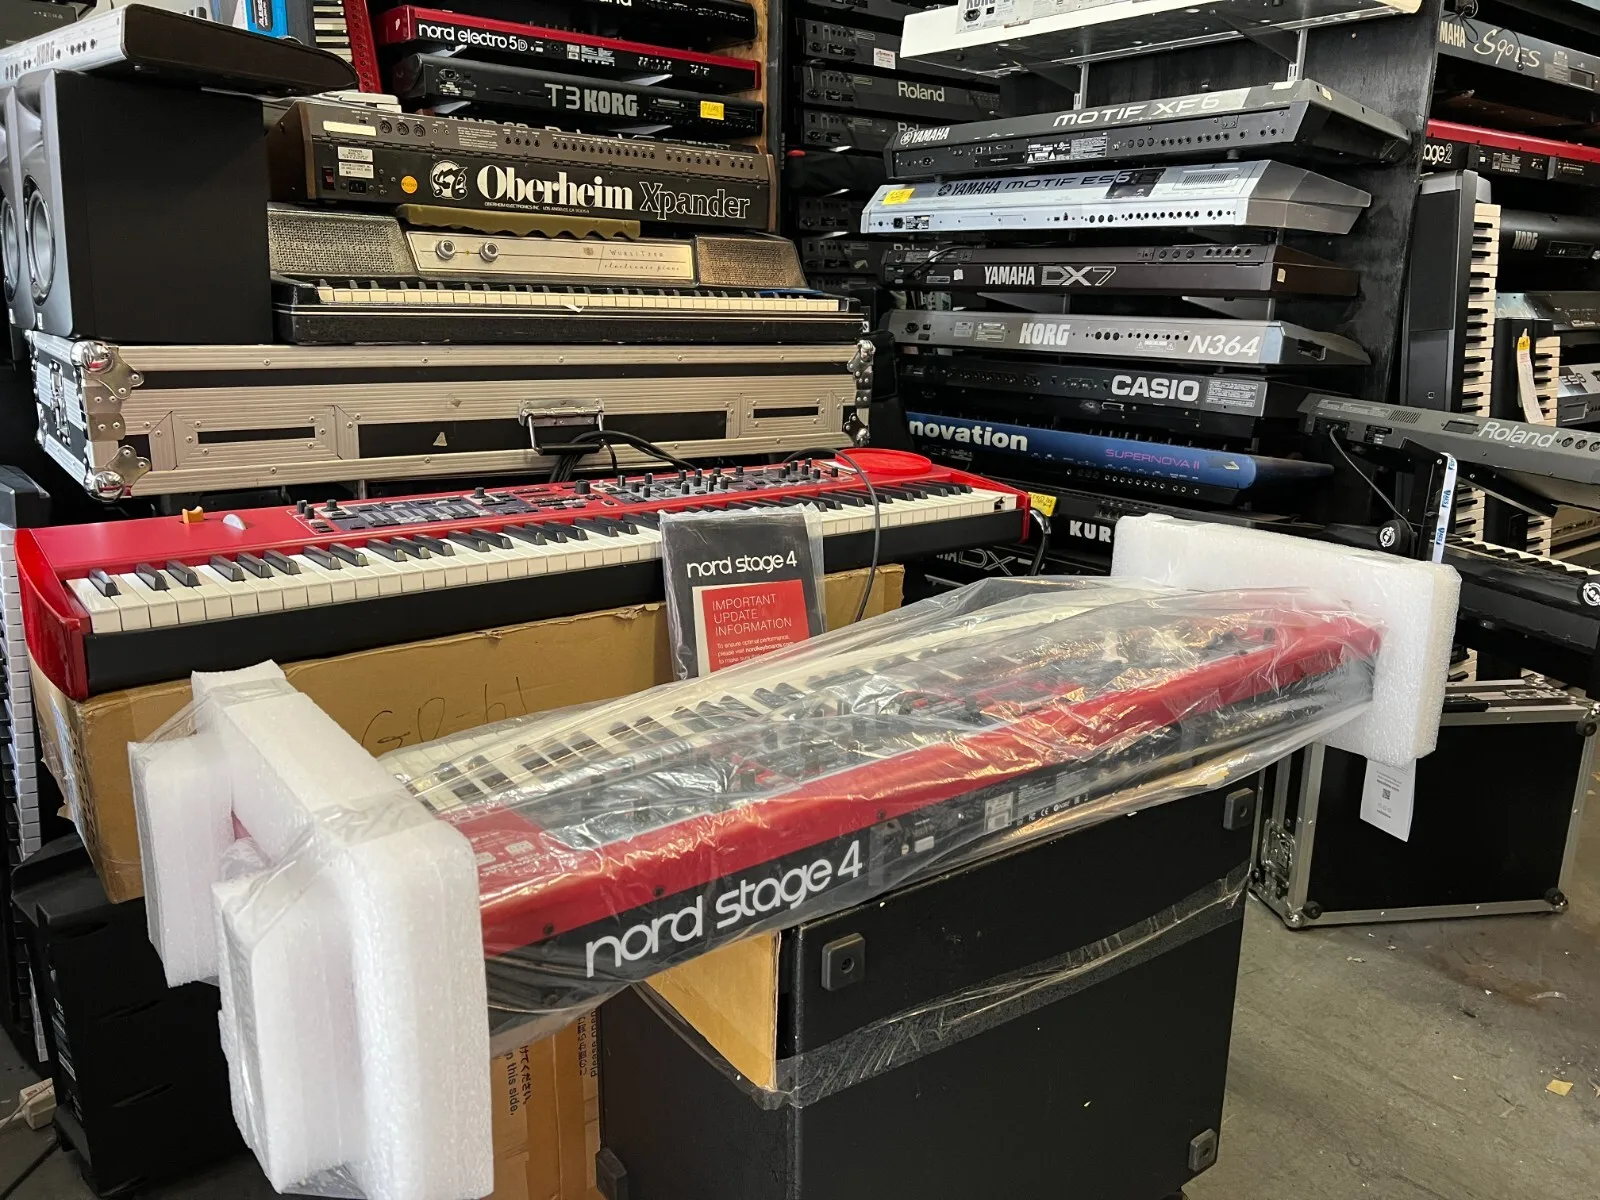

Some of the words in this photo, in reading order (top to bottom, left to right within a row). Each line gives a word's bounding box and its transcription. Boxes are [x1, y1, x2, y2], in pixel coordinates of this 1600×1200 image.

[418, 23, 454, 41] nord
[457, 29, 508, 49] electro
[583, 88, 638, 117] KORG
[897, 81, 945, 102] Roland
[1053, 104, 1148, 127] MOTIF
[911, 127, 950, 144] YAMAHA
[476, 164, 634, 211] Oberheim
[639, 181, 750, 220] Xpander
[950, 180, 1000, 196] YAMAHA
[1004, 177, 1077, 190] MOTIF
[1512, 230, 1539, 251] KORG
[984, 266, 1035, 285] YAMAHA
[1040, 265, 1117, 286] DX7
[1018, 322, 1070, 346] KORG
[1187, 334, 1260, 357] N364
[1111, 375, 1200, 402] CASIO
[908, 419, 1028, 452] novation
[1105, 448, 1190, 469] SUPERNOVA
[1192, 461, 1200, 469] II
[1478, 421, 1559, 448] Roland
[1069, 520, 1112, 543] KUR
[686, 556, 732, 578] nord
[735, 553, 784, 574] stage
[786, 550, 798, 567] 4
[958, 548, 1034, 577] DX
[712, 593, 777, 611] IMPORTANT
[713, 608, 759, 624] UPDATE
[715, 617, 792, 637] INFORMATION
[717, 650, 735, 658] please
[741, 639, 759, 647] optimal
[585, 896, 703, 978] nord
[715, 858, 832, 929] stage
[837, 839, 863, 878] 4
[507, 1062, 518, 1085] this
[509, 1087, 520, 1116] side.
